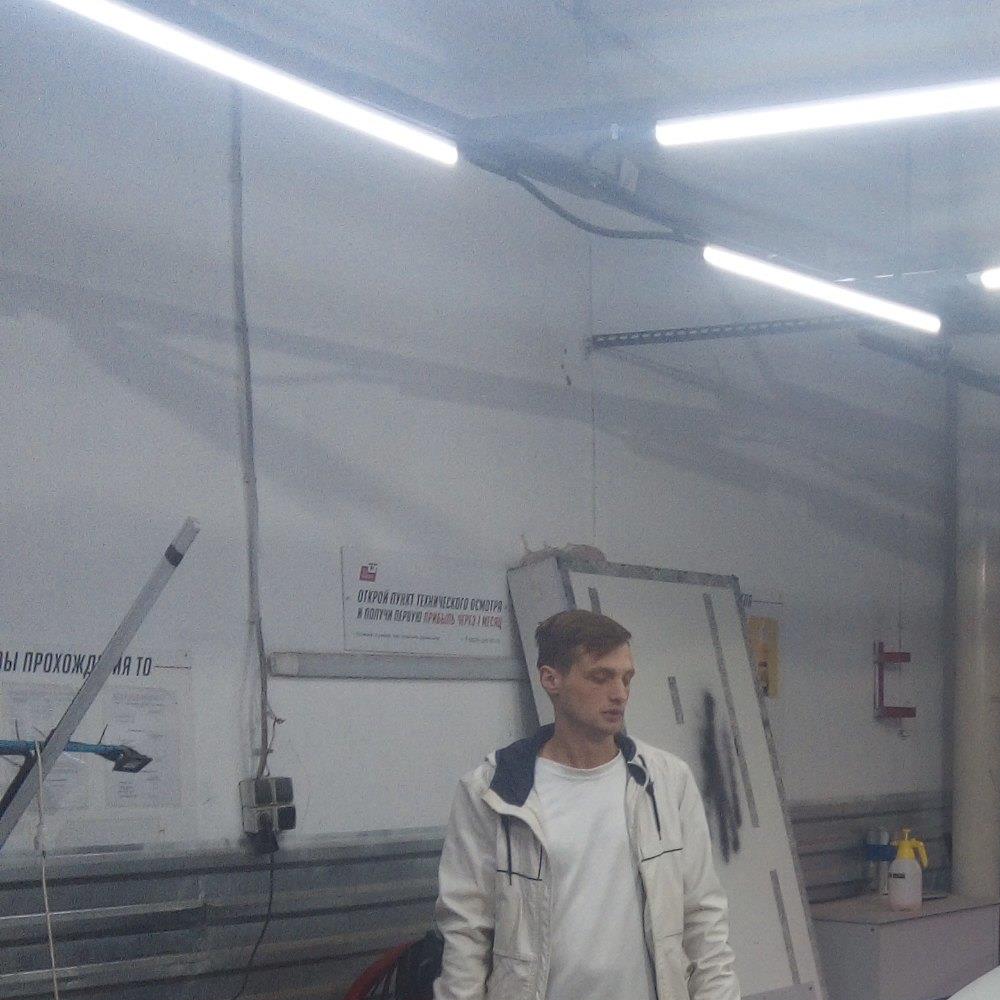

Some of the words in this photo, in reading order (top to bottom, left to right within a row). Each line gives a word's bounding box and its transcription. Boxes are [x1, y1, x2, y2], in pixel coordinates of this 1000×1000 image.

[357, 589, 389, 605] ОТКРОЙ
[390, 591, 415, 606] ПУНКТ
[416, 593, 469, 611] ТЕХНИЧЕСКОГО
[470, 598, 503, 613] ОСМОТРА
[364, 607, 393, 621] ПОЛУЧИ
[0, 651, 18, 672] Ы
[23, 651, 132, 679] ПРОХОЖДИЯ
[135, 656, 152, 676] ТО
